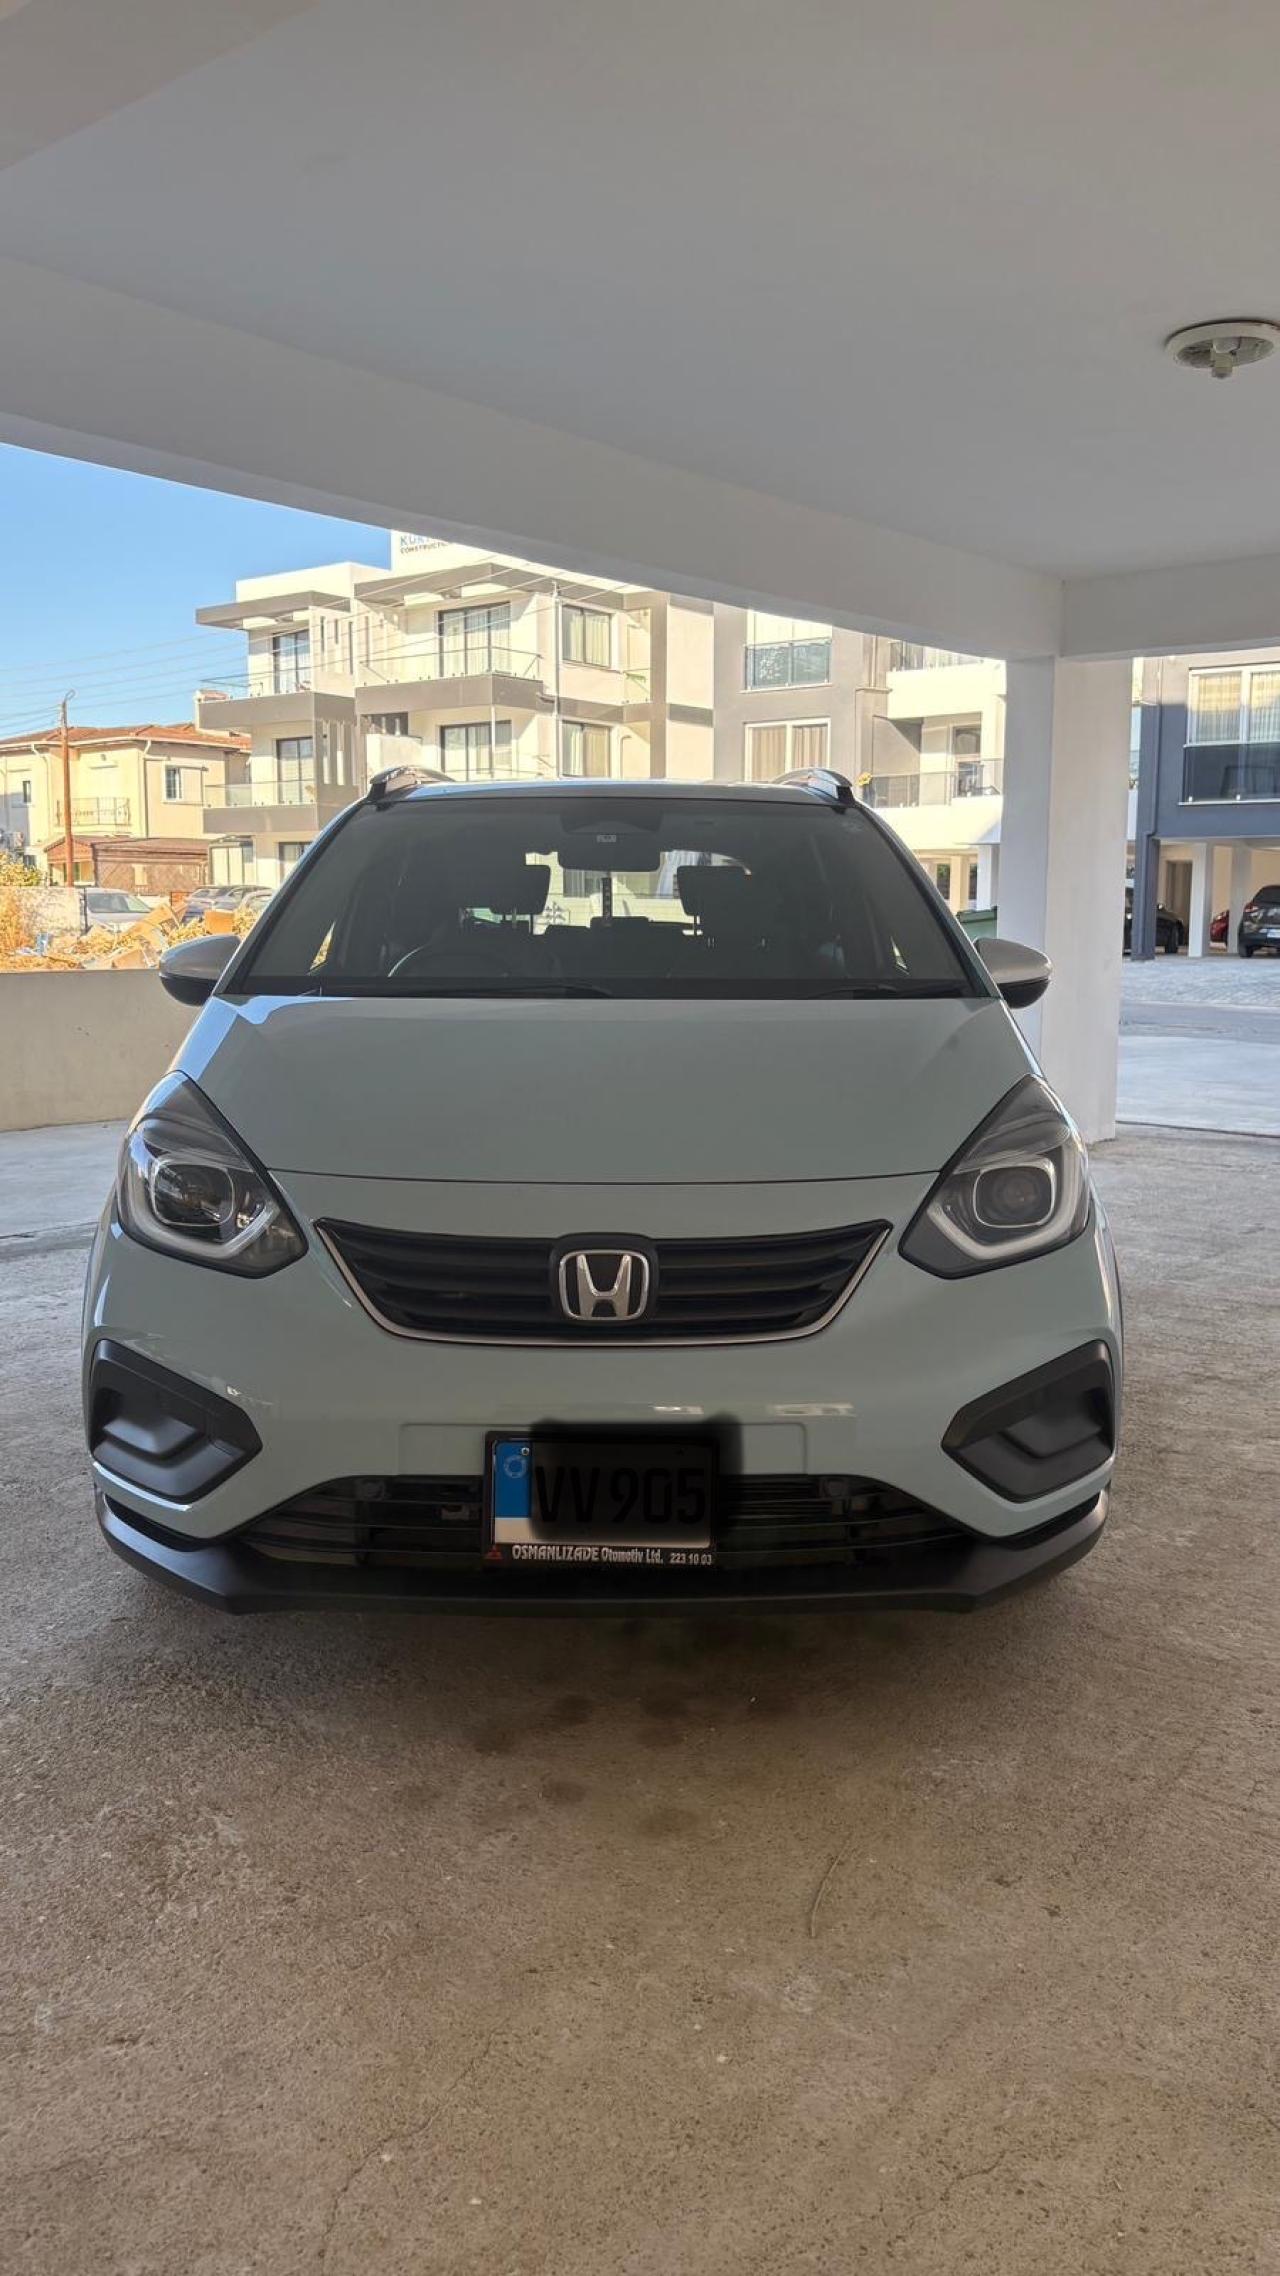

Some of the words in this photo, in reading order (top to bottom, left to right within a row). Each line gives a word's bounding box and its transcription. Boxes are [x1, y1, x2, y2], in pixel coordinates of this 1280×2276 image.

[535, 1466, 600, 1523] VV
[609, 1467, 706, 1524] 905
[511, 1544, 600, 1561] OSMANLIZADE
[601, 1547, 643, 1563] Otomotiv
[646, 1548, 664, 1564] Ltd.
[669, 1552, 686, 1564] 223
[688, 1553, 699, 1565] 10
[700, 1554, 712, 1566] 03
